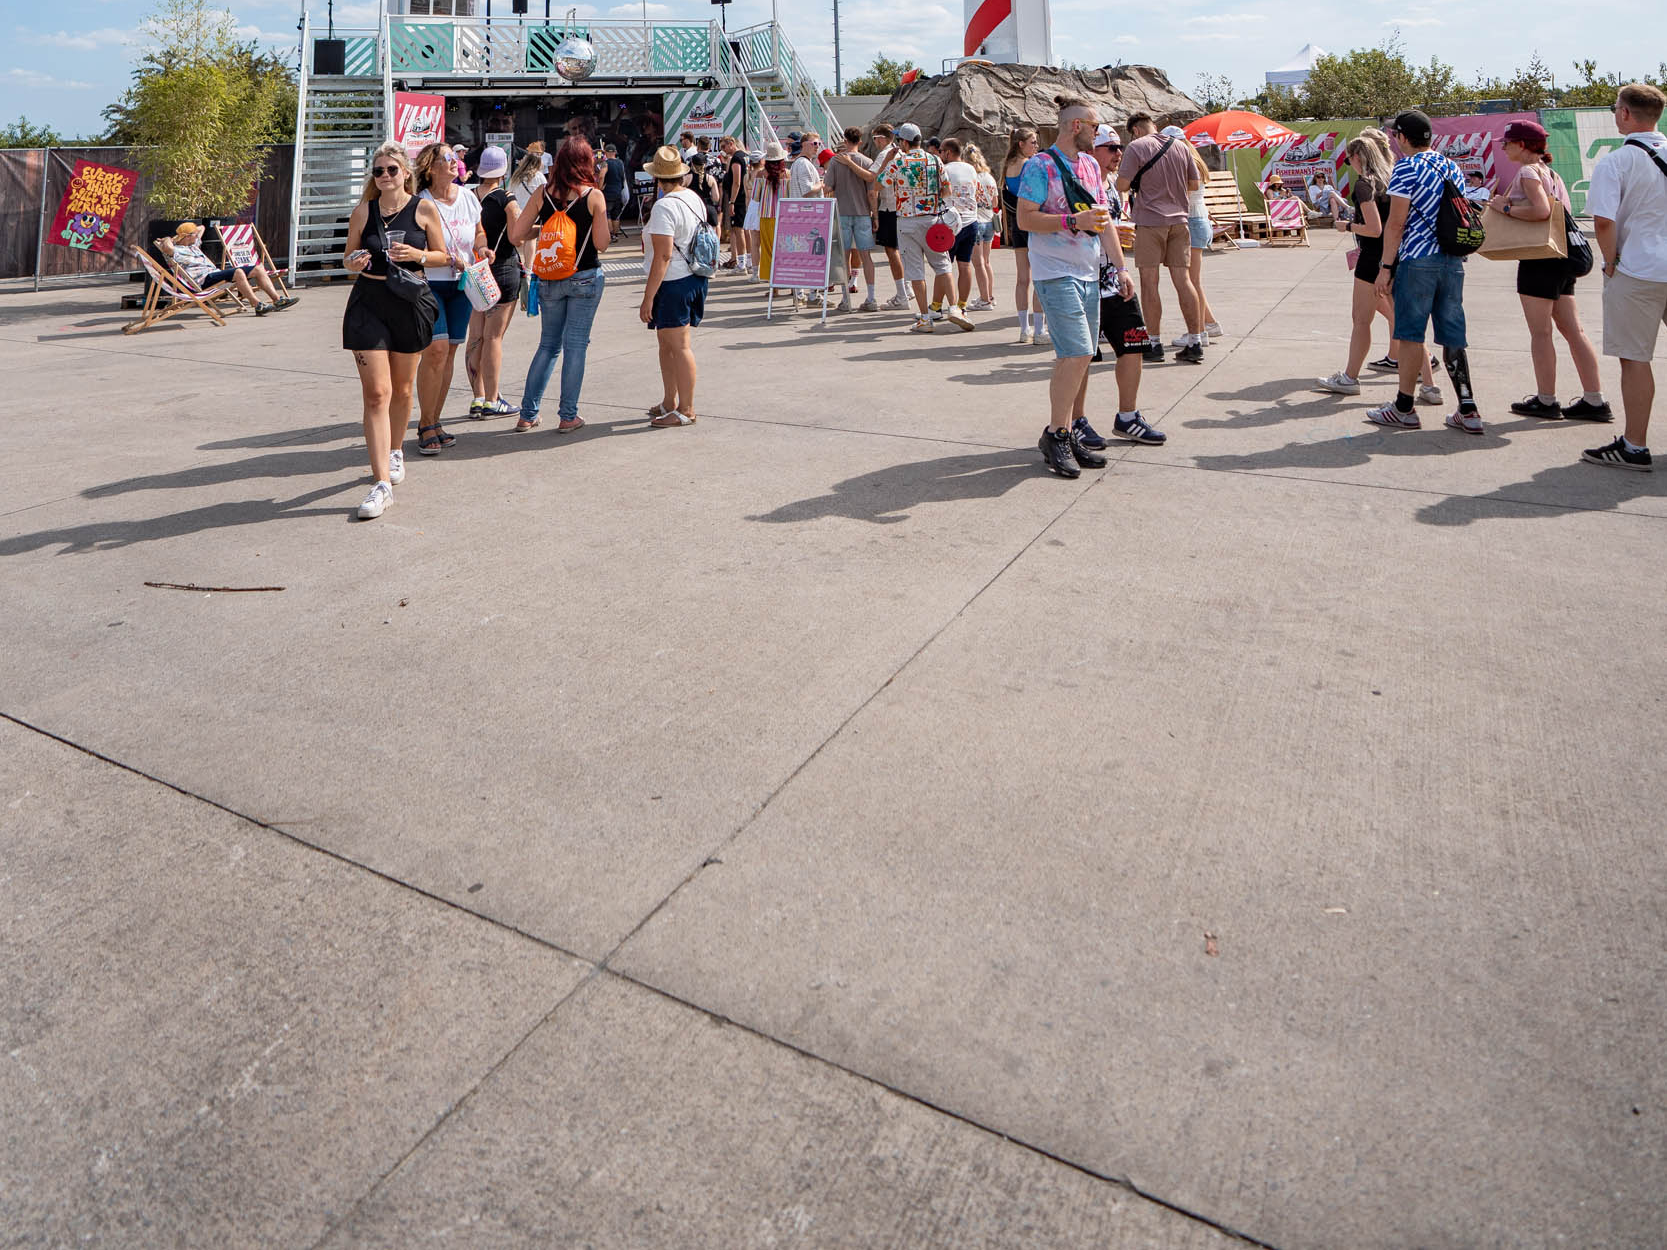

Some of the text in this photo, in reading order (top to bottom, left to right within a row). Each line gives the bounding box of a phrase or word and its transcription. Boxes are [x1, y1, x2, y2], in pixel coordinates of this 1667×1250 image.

[82, 166, 123, 184] EVERY
[1275, 167, 1311, 176] FISHERMAN'S
[101, 193, 118, 205] BE
